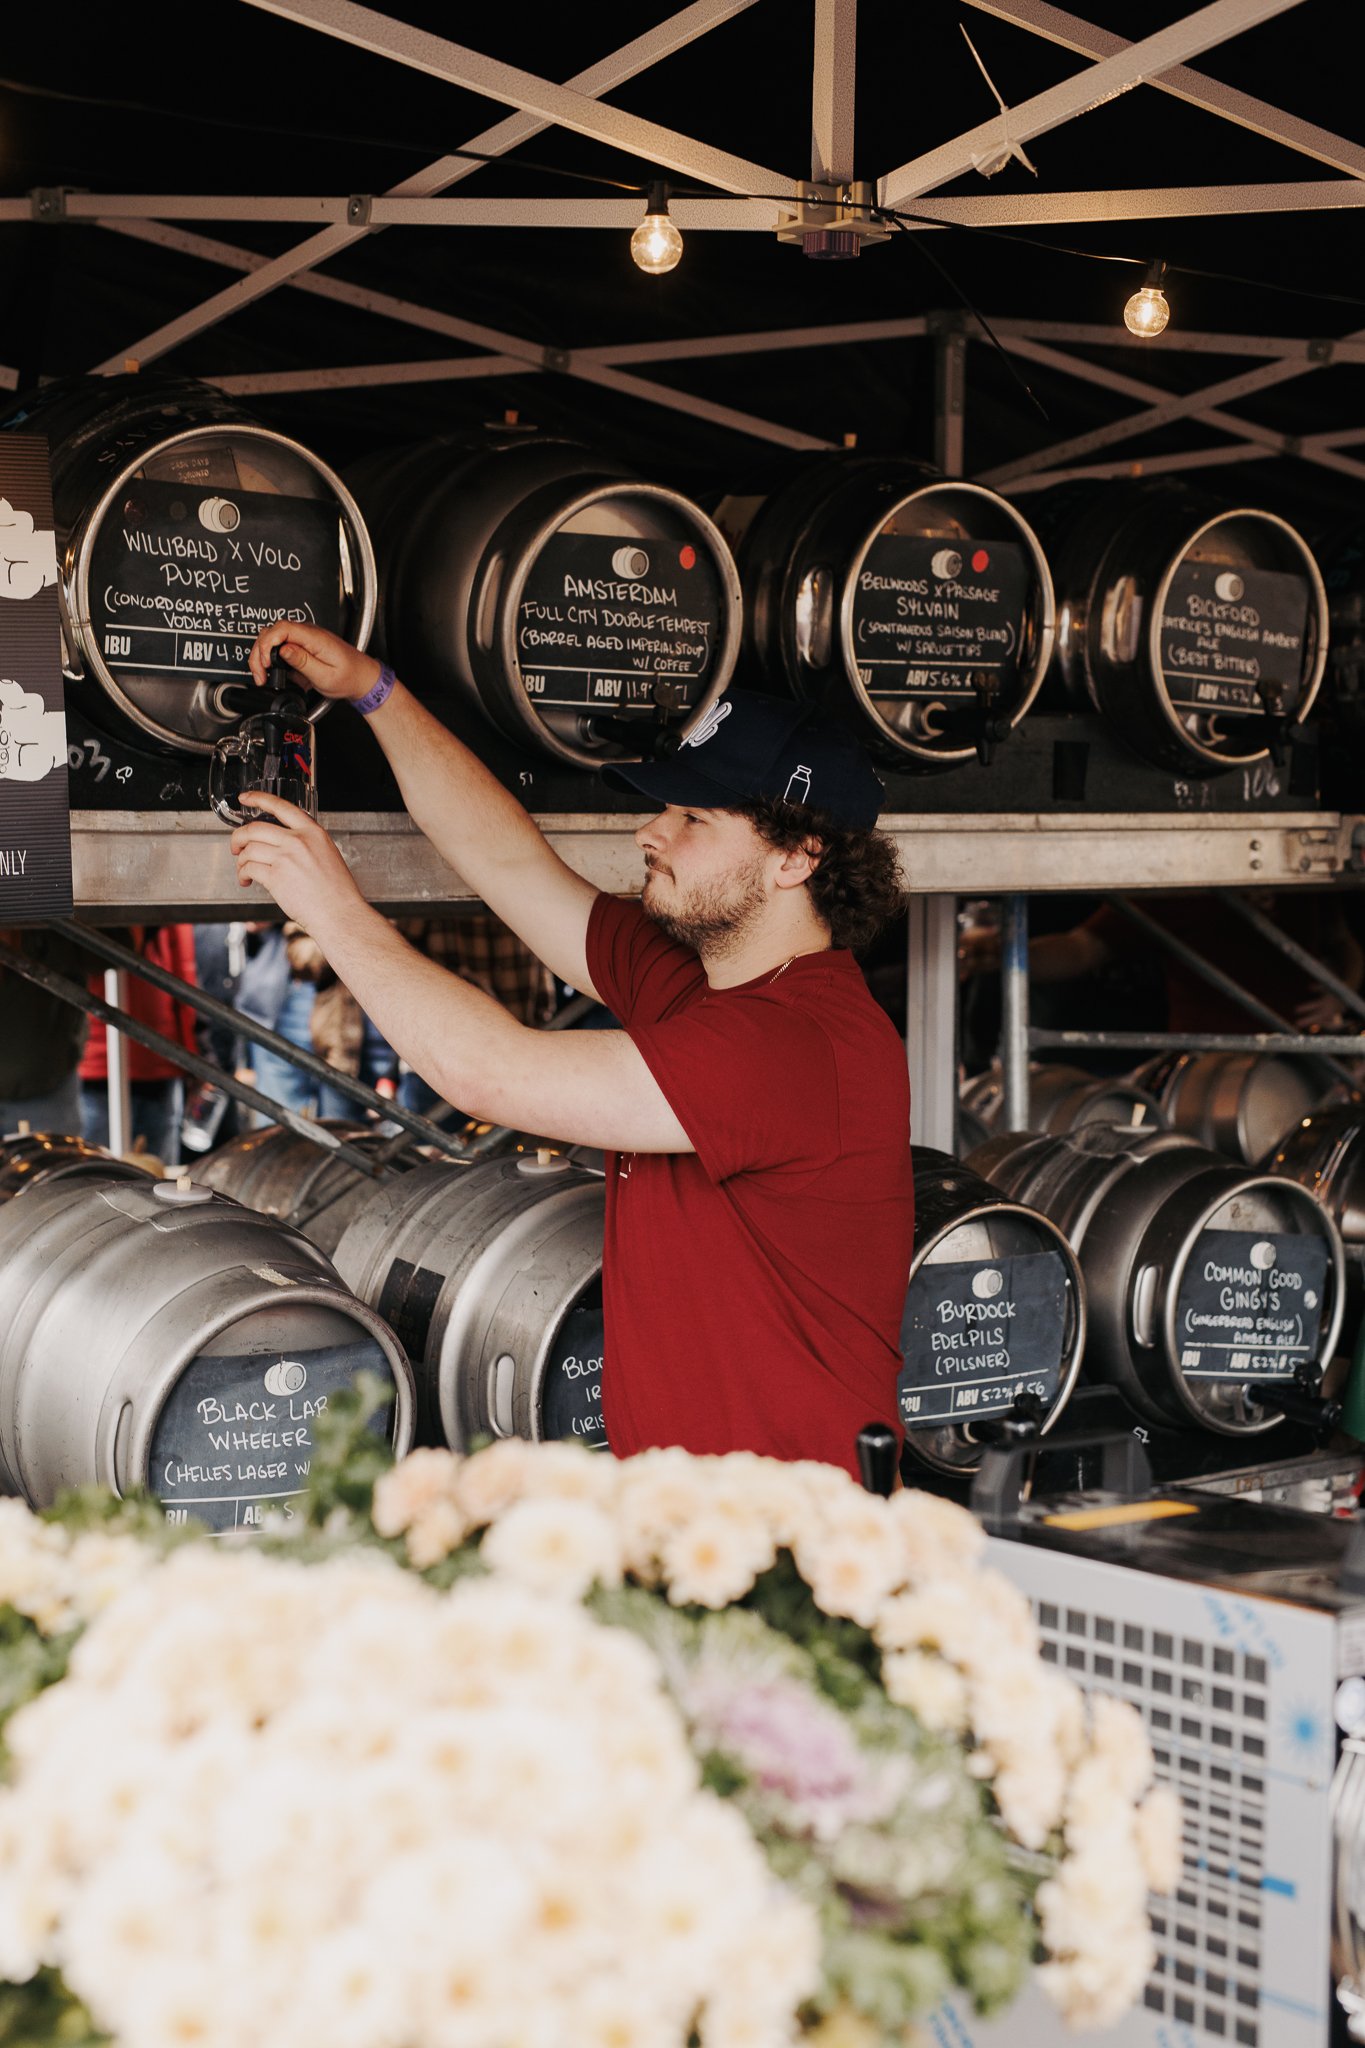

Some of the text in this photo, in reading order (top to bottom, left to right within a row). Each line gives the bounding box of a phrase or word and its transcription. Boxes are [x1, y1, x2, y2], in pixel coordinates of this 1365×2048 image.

[123, 529, 301, 571] WILLIBALD X VOLO
[160, 563, 250, 594] PURPLE
[564, 574, 678, 606] AMSTERDAM
[860, 571, 929, 595] BELLWOODS
[944, 580, 1000, 602] PASSAGE
[521, 602, 710, 635] FULL CITY DOUBLE TEMPEST
[897, 597, 959, 620] SYLVAIN
[1187, 594, 1260, 627] BICKFORD
[163, 612, 274, 634] VODKA SELTZE
[938, 622, 973, 639] SAISON
[105, 635, 131, 655] IBU
[183, 641, 213, 661] ABV
[520, 627, 581, 649] (BARREL
[587, 636, 623, 651] AGED
[627, 638, 674, 654] IMPERIAL
[1197, 636, 1221, 651] ALE
[633, 657, 649, 670] W/
[594, 679, 622, 697] ABV
[626, 681, 652, 699] 11.9
[906, 669, 929, 686] ABV
[519, 772, 533, 786] 51
[1204, 1261, 1303, 1290] COMMON GOOD
[1220, 1287, 1281, 1311] GINGY'S
[936, 1300, 1017, 1324] BURDOCK
[1256, 1317, 1295, 1333] ENGLISH
[931, 1328, 1004, 1351] EDELPILS
[1234, 1331, 1273, 1345] AMBER
[935, 1349, 1011, 1376] (PILSNER)
[1181, 1351, 1201, 1367] IBU
[1230, 1352, 1251, 1369] ABV
[956, 1389, 979, 1407] ABV
[197, 1397, 277, 1425] BLACK
[208, 1427, 312, 1451] WHEELER
[164, 1461, 311, 1487] (HELLES LAGER W/
[166, 1509, 188, 1526] BU
[243, 1506, 264, 1525] AB
